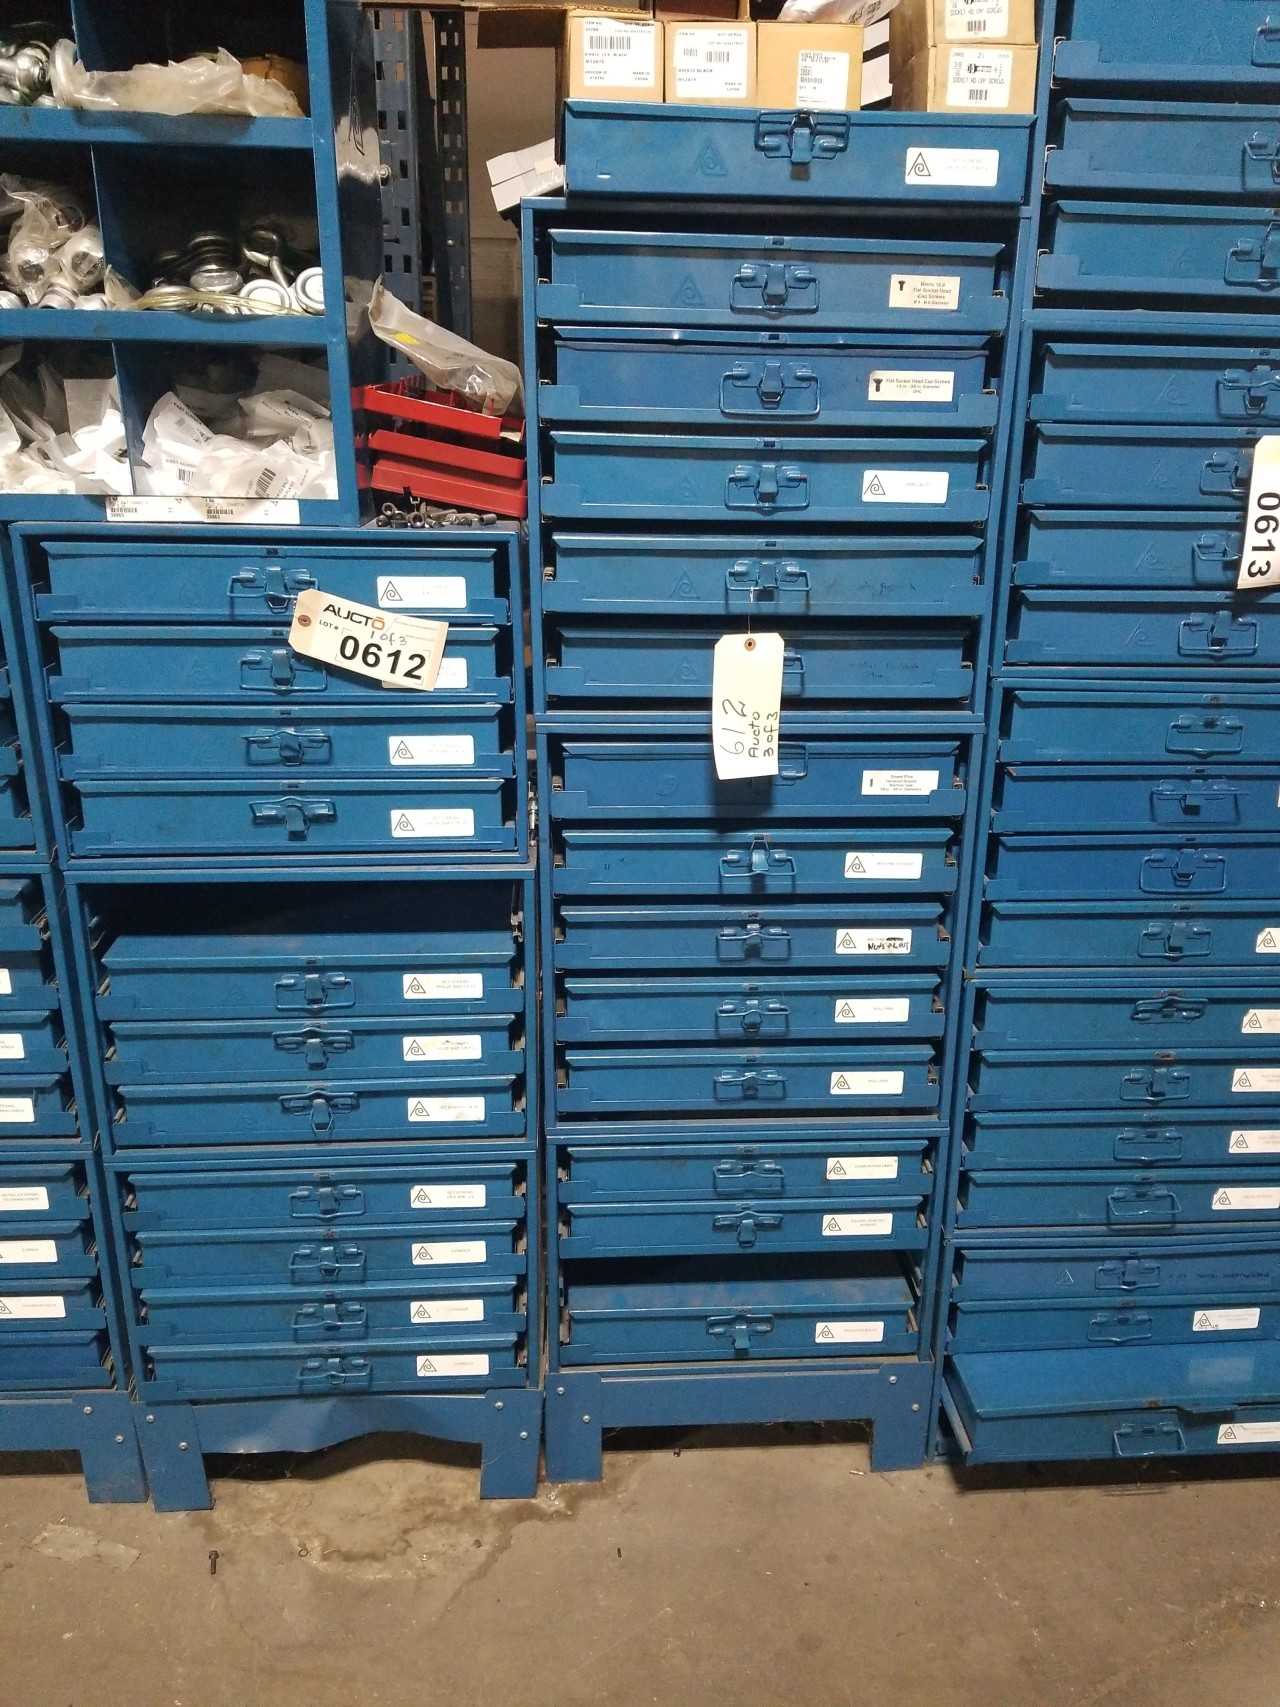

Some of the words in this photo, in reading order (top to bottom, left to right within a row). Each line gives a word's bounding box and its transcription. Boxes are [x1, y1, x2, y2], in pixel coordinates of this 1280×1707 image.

[1248, 492, 1280, 578] 0613
[319, 619, 333, 629] LOT
[340, 635, 426, 681] 0612
